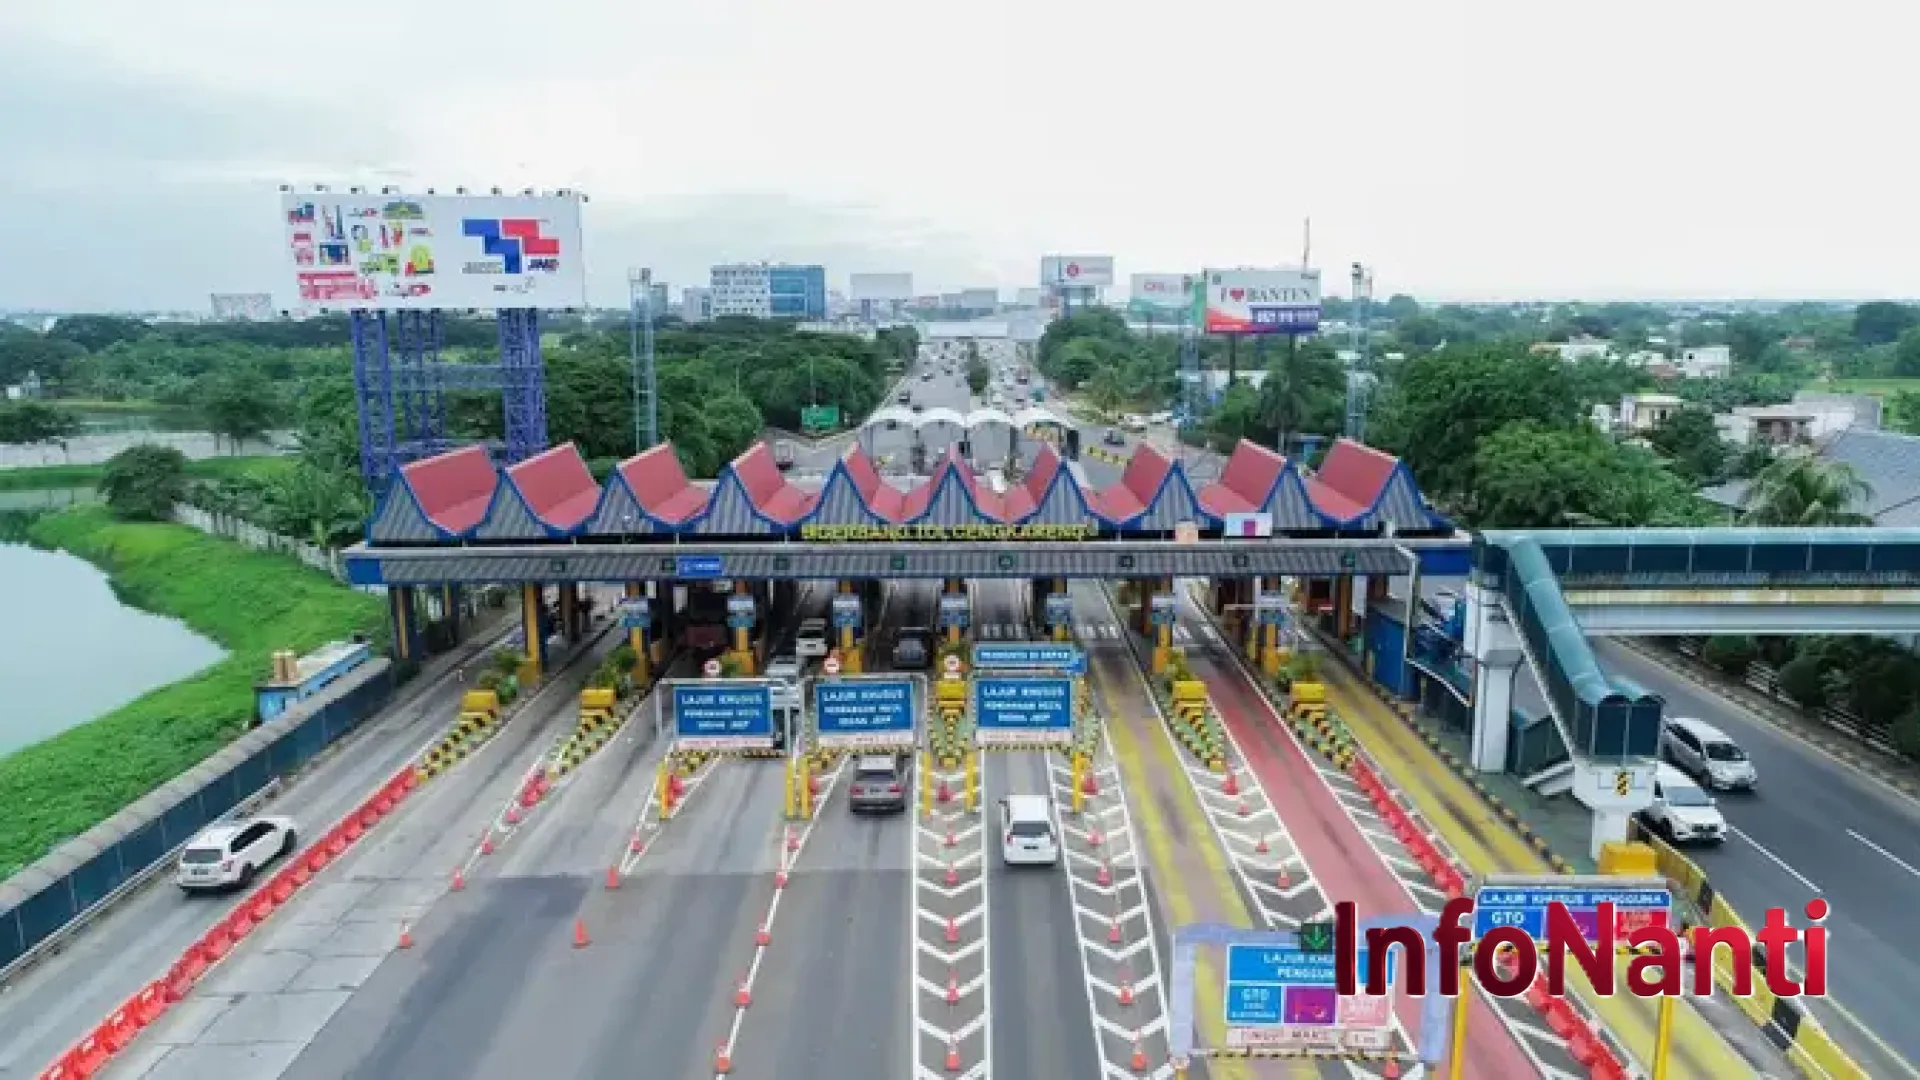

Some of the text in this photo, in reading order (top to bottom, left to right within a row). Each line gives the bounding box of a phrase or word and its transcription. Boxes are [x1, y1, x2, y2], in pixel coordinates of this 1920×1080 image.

[822, 688, 904, 702] LAJUR KHUSUS
[983, 685, 1065, 697] LAJUR KHUSUS
[681, 692, 763, 705] LAJUR KHUSUS
[1482, 893, 1664, 905] LAJUR KHUSUS PENGGUNA
[1491, 911, 1524, 925] GTO
[1277, 968, 1336, 979] PENGGUN
